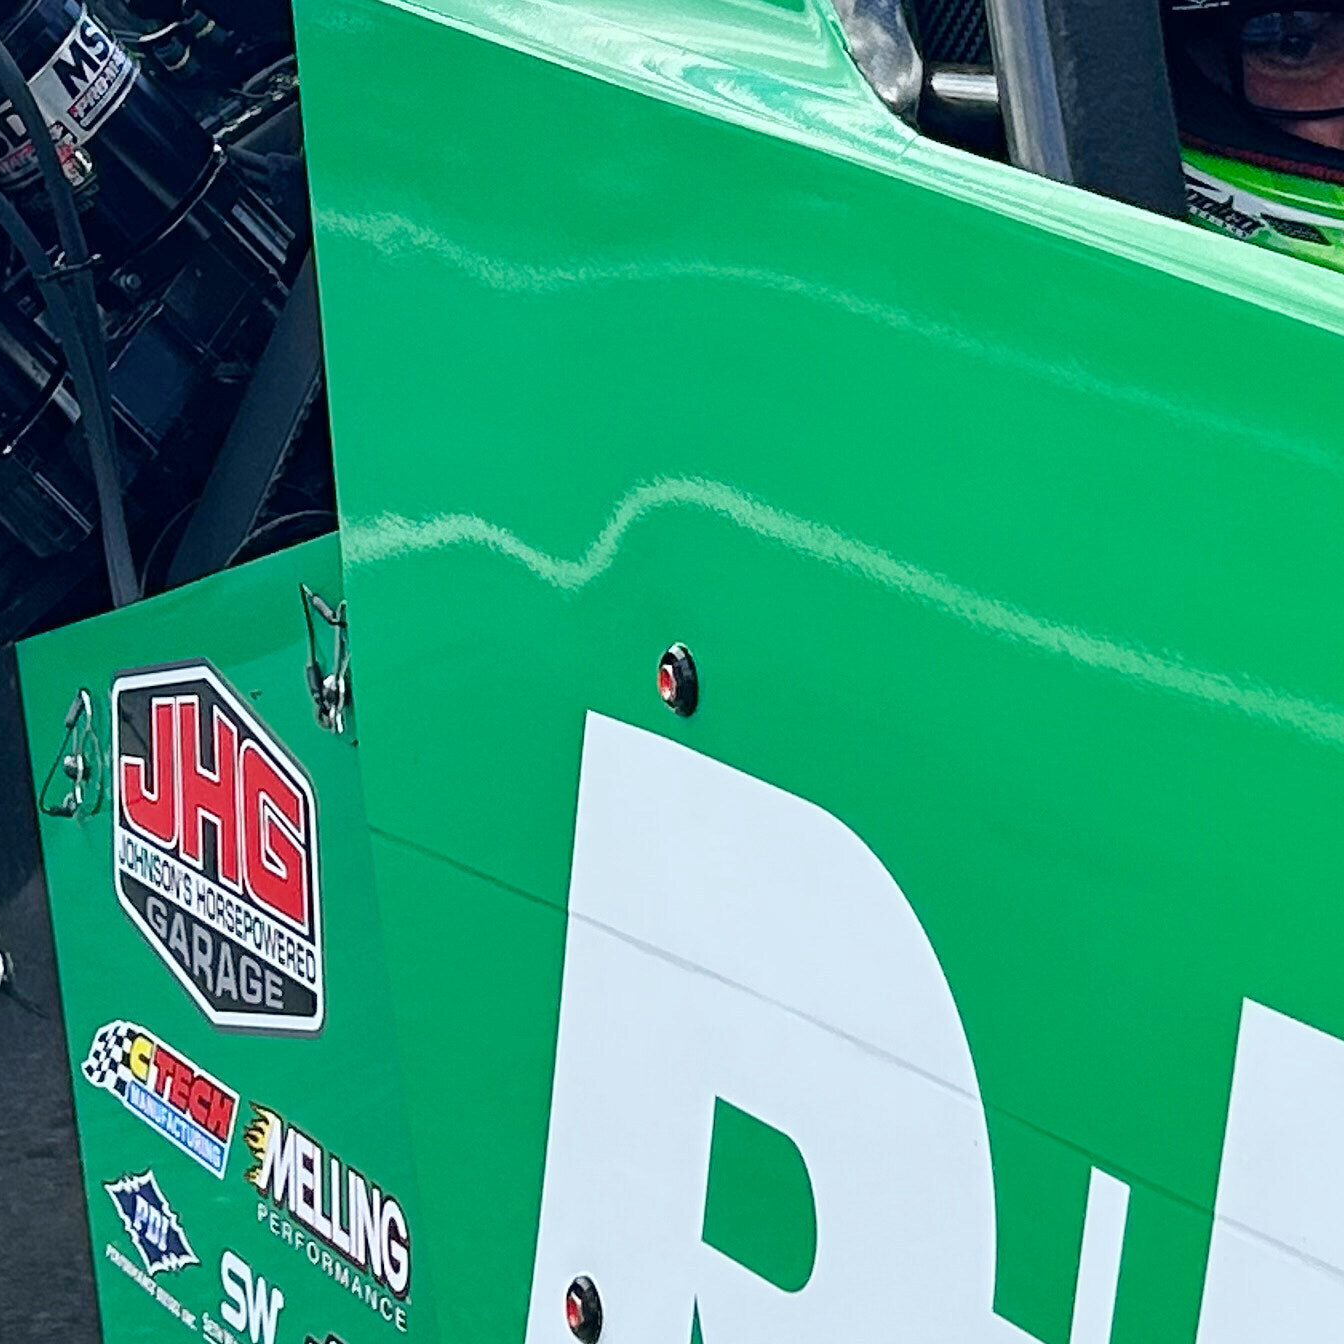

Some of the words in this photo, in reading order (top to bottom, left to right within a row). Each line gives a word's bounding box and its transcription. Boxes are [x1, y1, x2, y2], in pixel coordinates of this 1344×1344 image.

[119, 694, 311, 936] JHG
[118, 829, 193, 906] JOHNSON'S
[196, 876, 317, 984] HORSEPOWERED
[145, 895, 286, 1010] GARAGE
[257, 1111, 410, 1294] MELLING
[257, 1202, 408, 1333] PERFORMANCE
